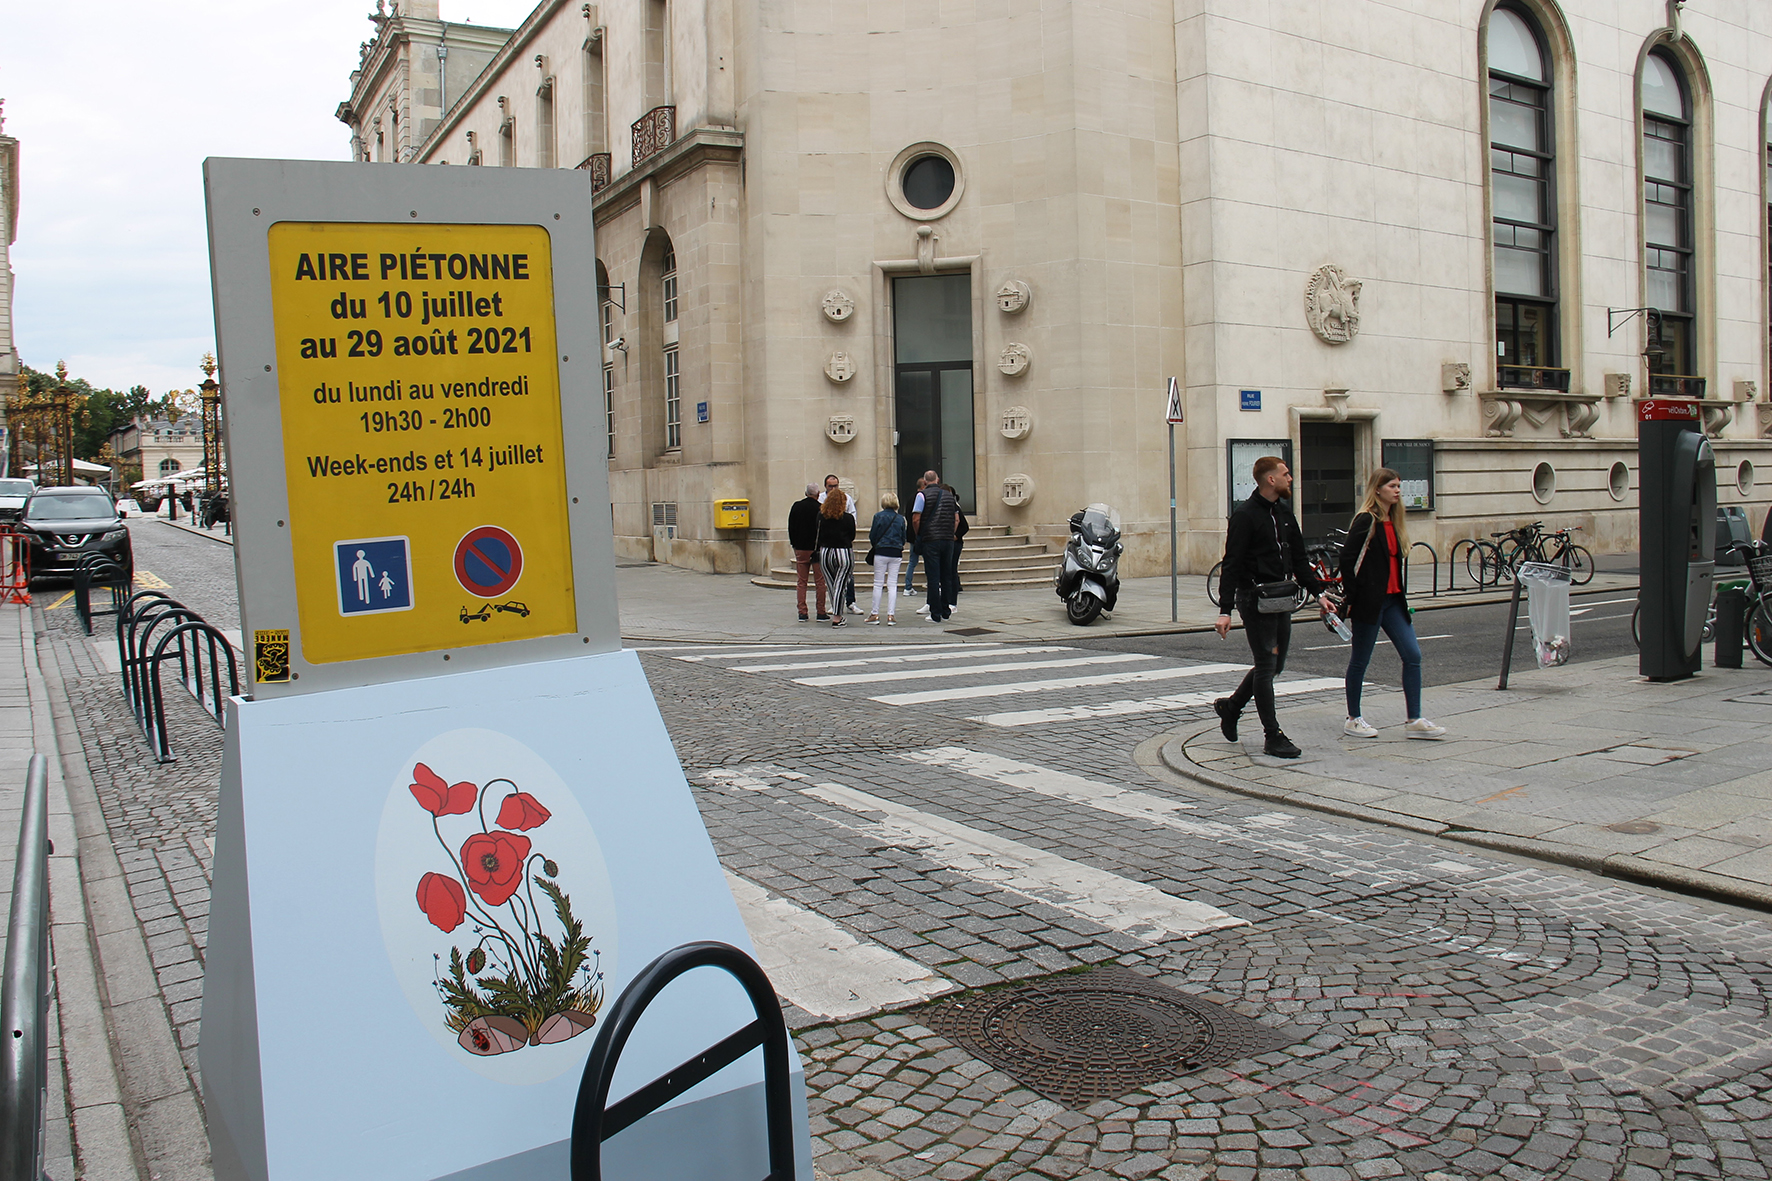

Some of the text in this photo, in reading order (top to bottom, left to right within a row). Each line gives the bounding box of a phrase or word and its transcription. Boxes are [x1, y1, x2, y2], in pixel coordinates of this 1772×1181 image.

[294, 246, 530, 281] AIRE PIÉTONNE
[330, 290, 503, 325] du 10 juillet
[300, 326, 531, 360] au 29 août 2021
[313, 375, 529, 404] du lundi au vendredi
[360, 409, 423, 433] 19h30
[442, 406, 491, 429] 2h00
[306, 444, 544, 478] Week-ends et 14 juillet
